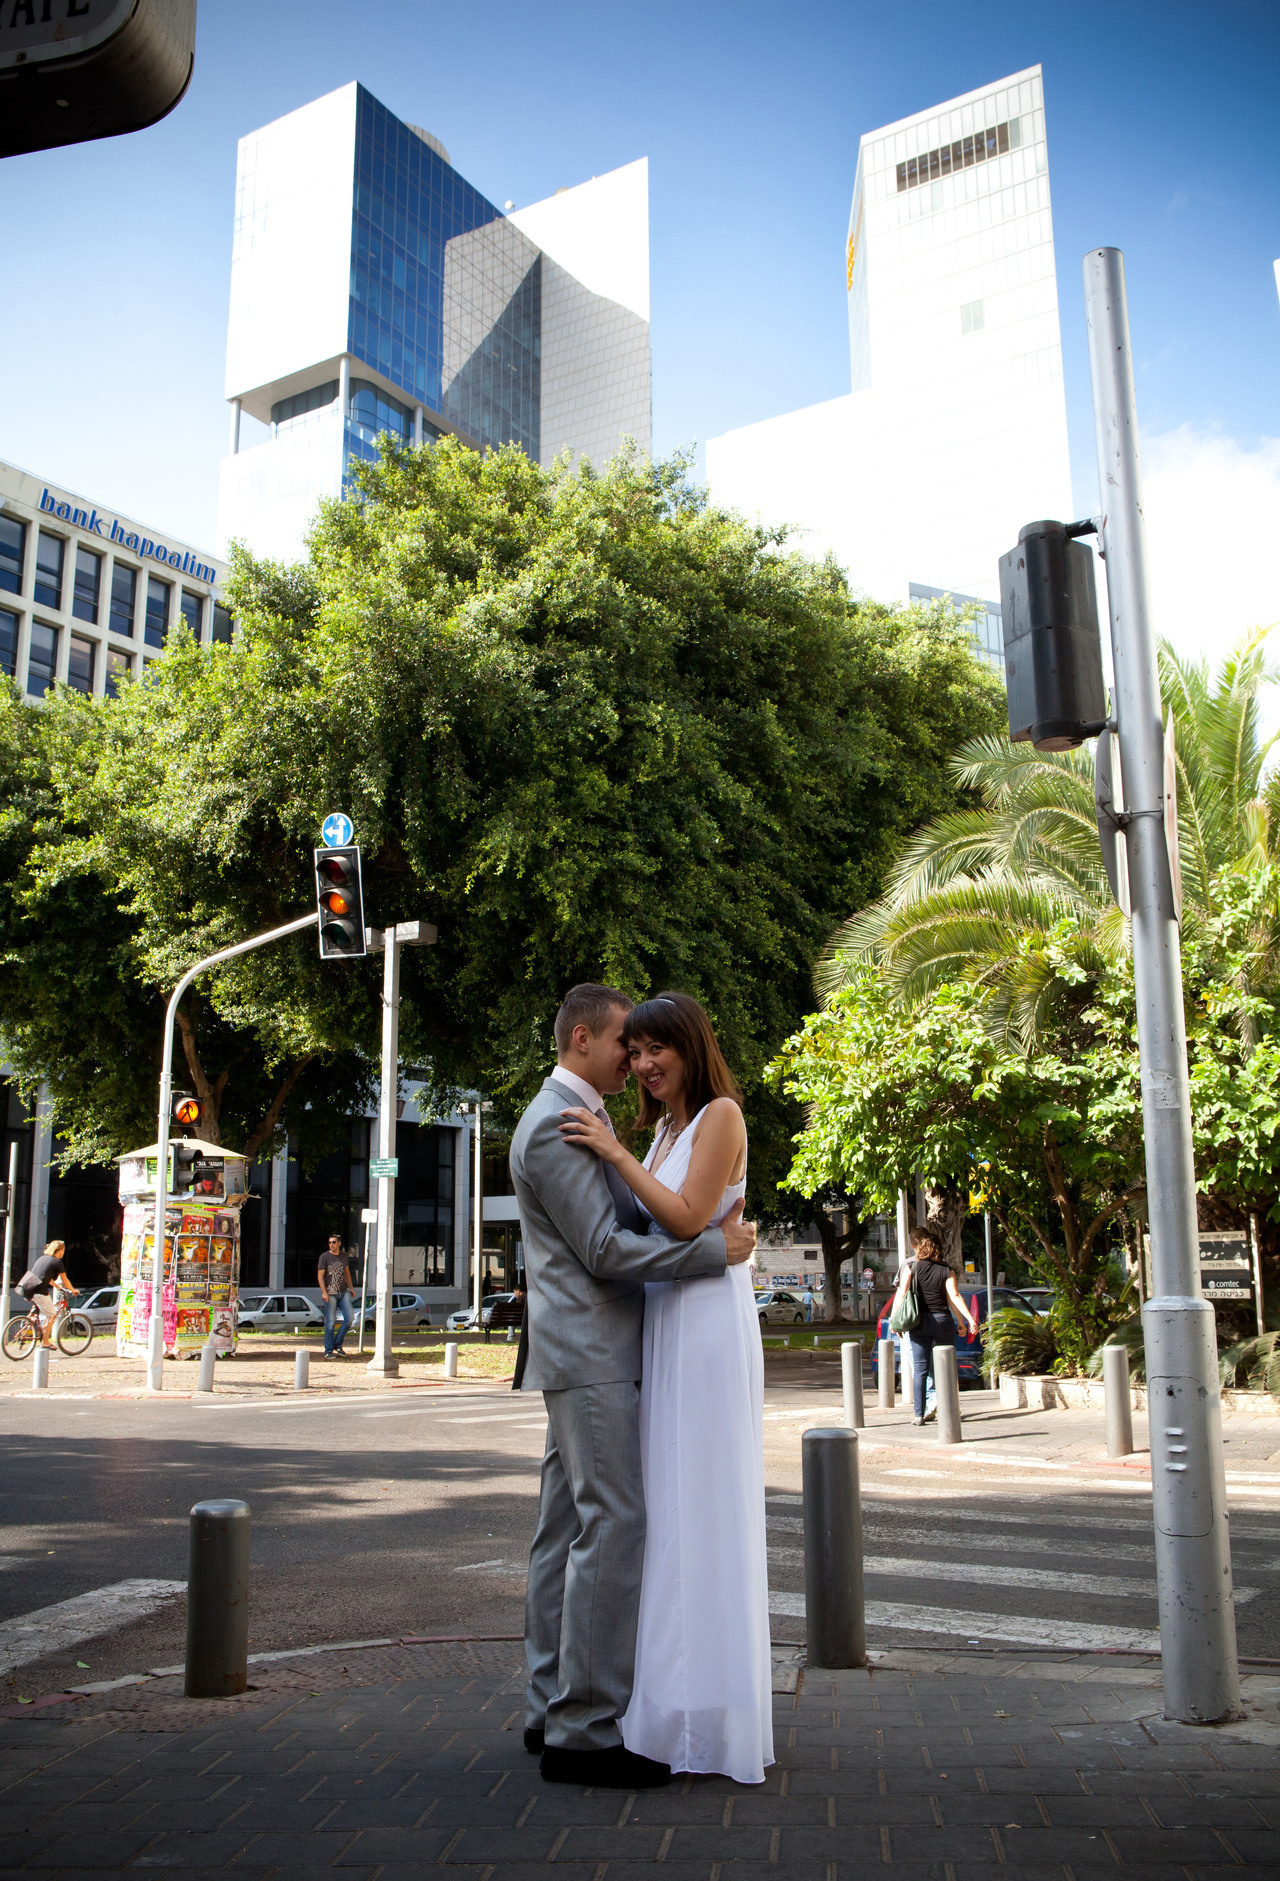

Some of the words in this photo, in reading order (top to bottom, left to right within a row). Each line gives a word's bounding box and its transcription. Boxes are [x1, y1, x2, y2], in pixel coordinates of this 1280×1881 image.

[39, 487, 104, 535] bank
[110, 519, 217, 584] hapoalim
[1216, 1280, 1240, 1288] comtec
